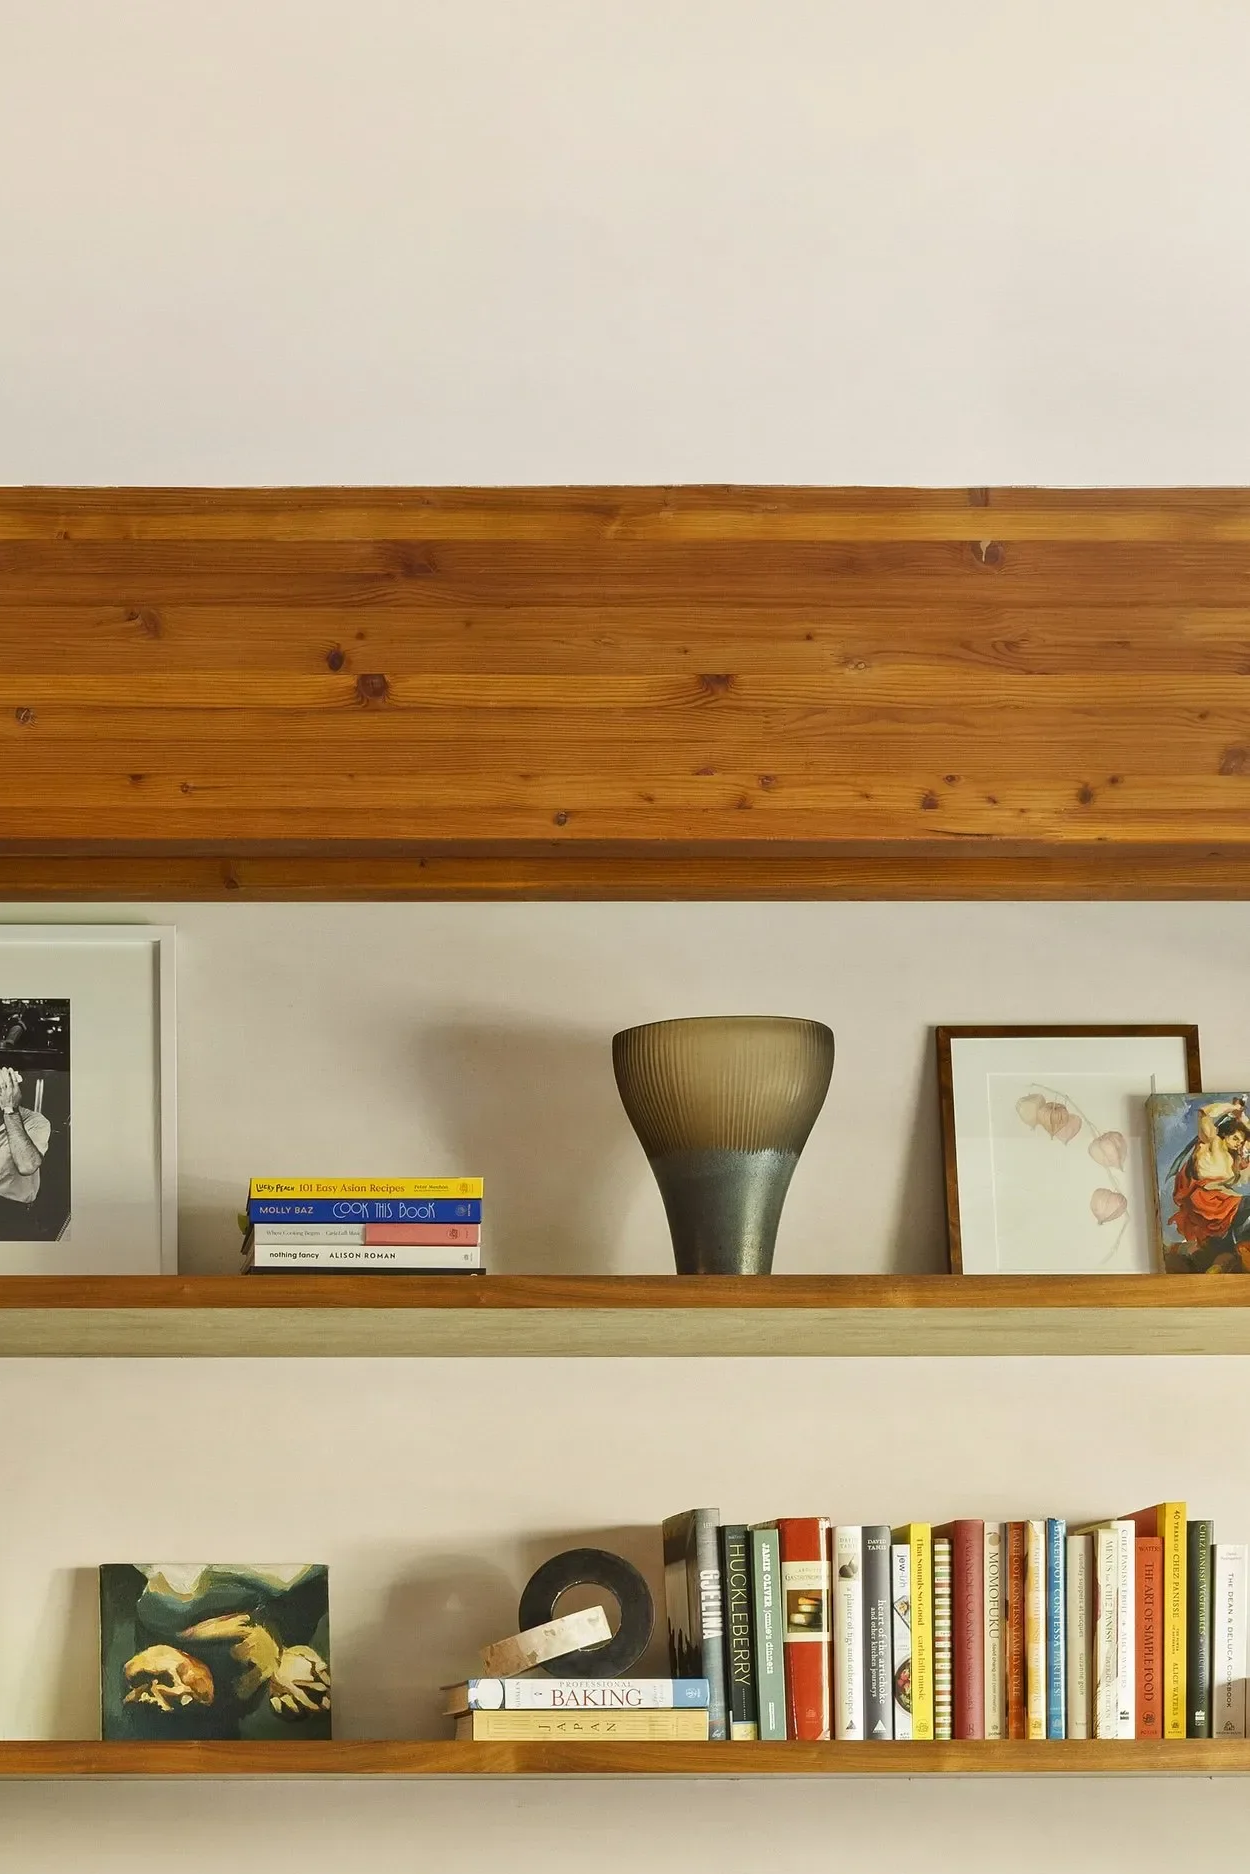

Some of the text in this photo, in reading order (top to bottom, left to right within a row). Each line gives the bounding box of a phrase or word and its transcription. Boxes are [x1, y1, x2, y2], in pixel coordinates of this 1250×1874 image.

[295, 1206, 314, 1214] BAZ
[299, 1184, 313, 1192] 101
[316, 1184, 337, 1193] Easy
[340, 1184, 366, 1192] Asian
[370, 1184, 405, 1194] Recipes
[333, 1202, 369, 1218] COOK
[399, 1202, 436, 1218] BOOK
[269, 1251, 319, 1260] nothing fancy
[699, 1570, 723, 1640] GJELINA
[762, 1543, 772, 1607] JAMIE OLIVER
[916, 1538, 925, 1626] That Sounds So Good
[988, 1552, 1000, 1640] MOMOFUKU
[1172, 1582, 1180, 1618] PANISSE
[1198, 1525, 1207, 1635] CHEZ PANISSE VEGETABLES
[729, 1544, 751, 1686] HUCKLEBERRY
[762, 1609, 774, 1674] jamie's dinners
[1144, 1562, 1155, 1701] THE ART OF SIMPLE FOOD
[559, 1680, 633, 1688] PROFESSIONAL
[878, 1600, 888, 1704] heart of the artichoke
[538, 1723, 617, 1732] JAPAN
[551, 1689, 643, 1707] BAKING
